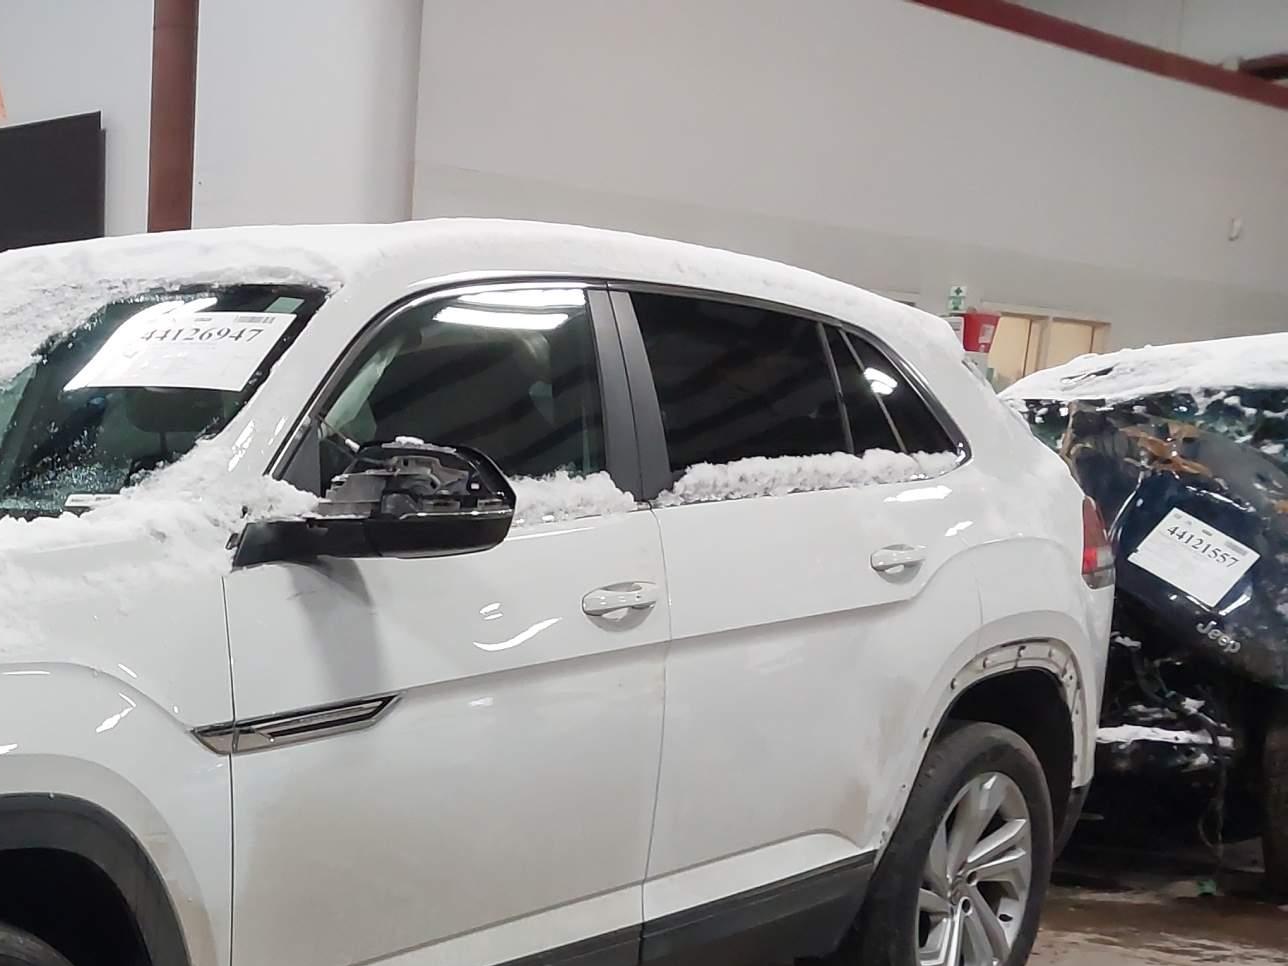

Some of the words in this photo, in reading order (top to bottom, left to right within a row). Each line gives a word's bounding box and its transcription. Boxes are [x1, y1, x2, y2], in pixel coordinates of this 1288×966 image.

[140, 327, 266, 343] 44126947
[1166, 525, 1240, 569] 44121557
[1196, 619, 1241, 654] Jeep
